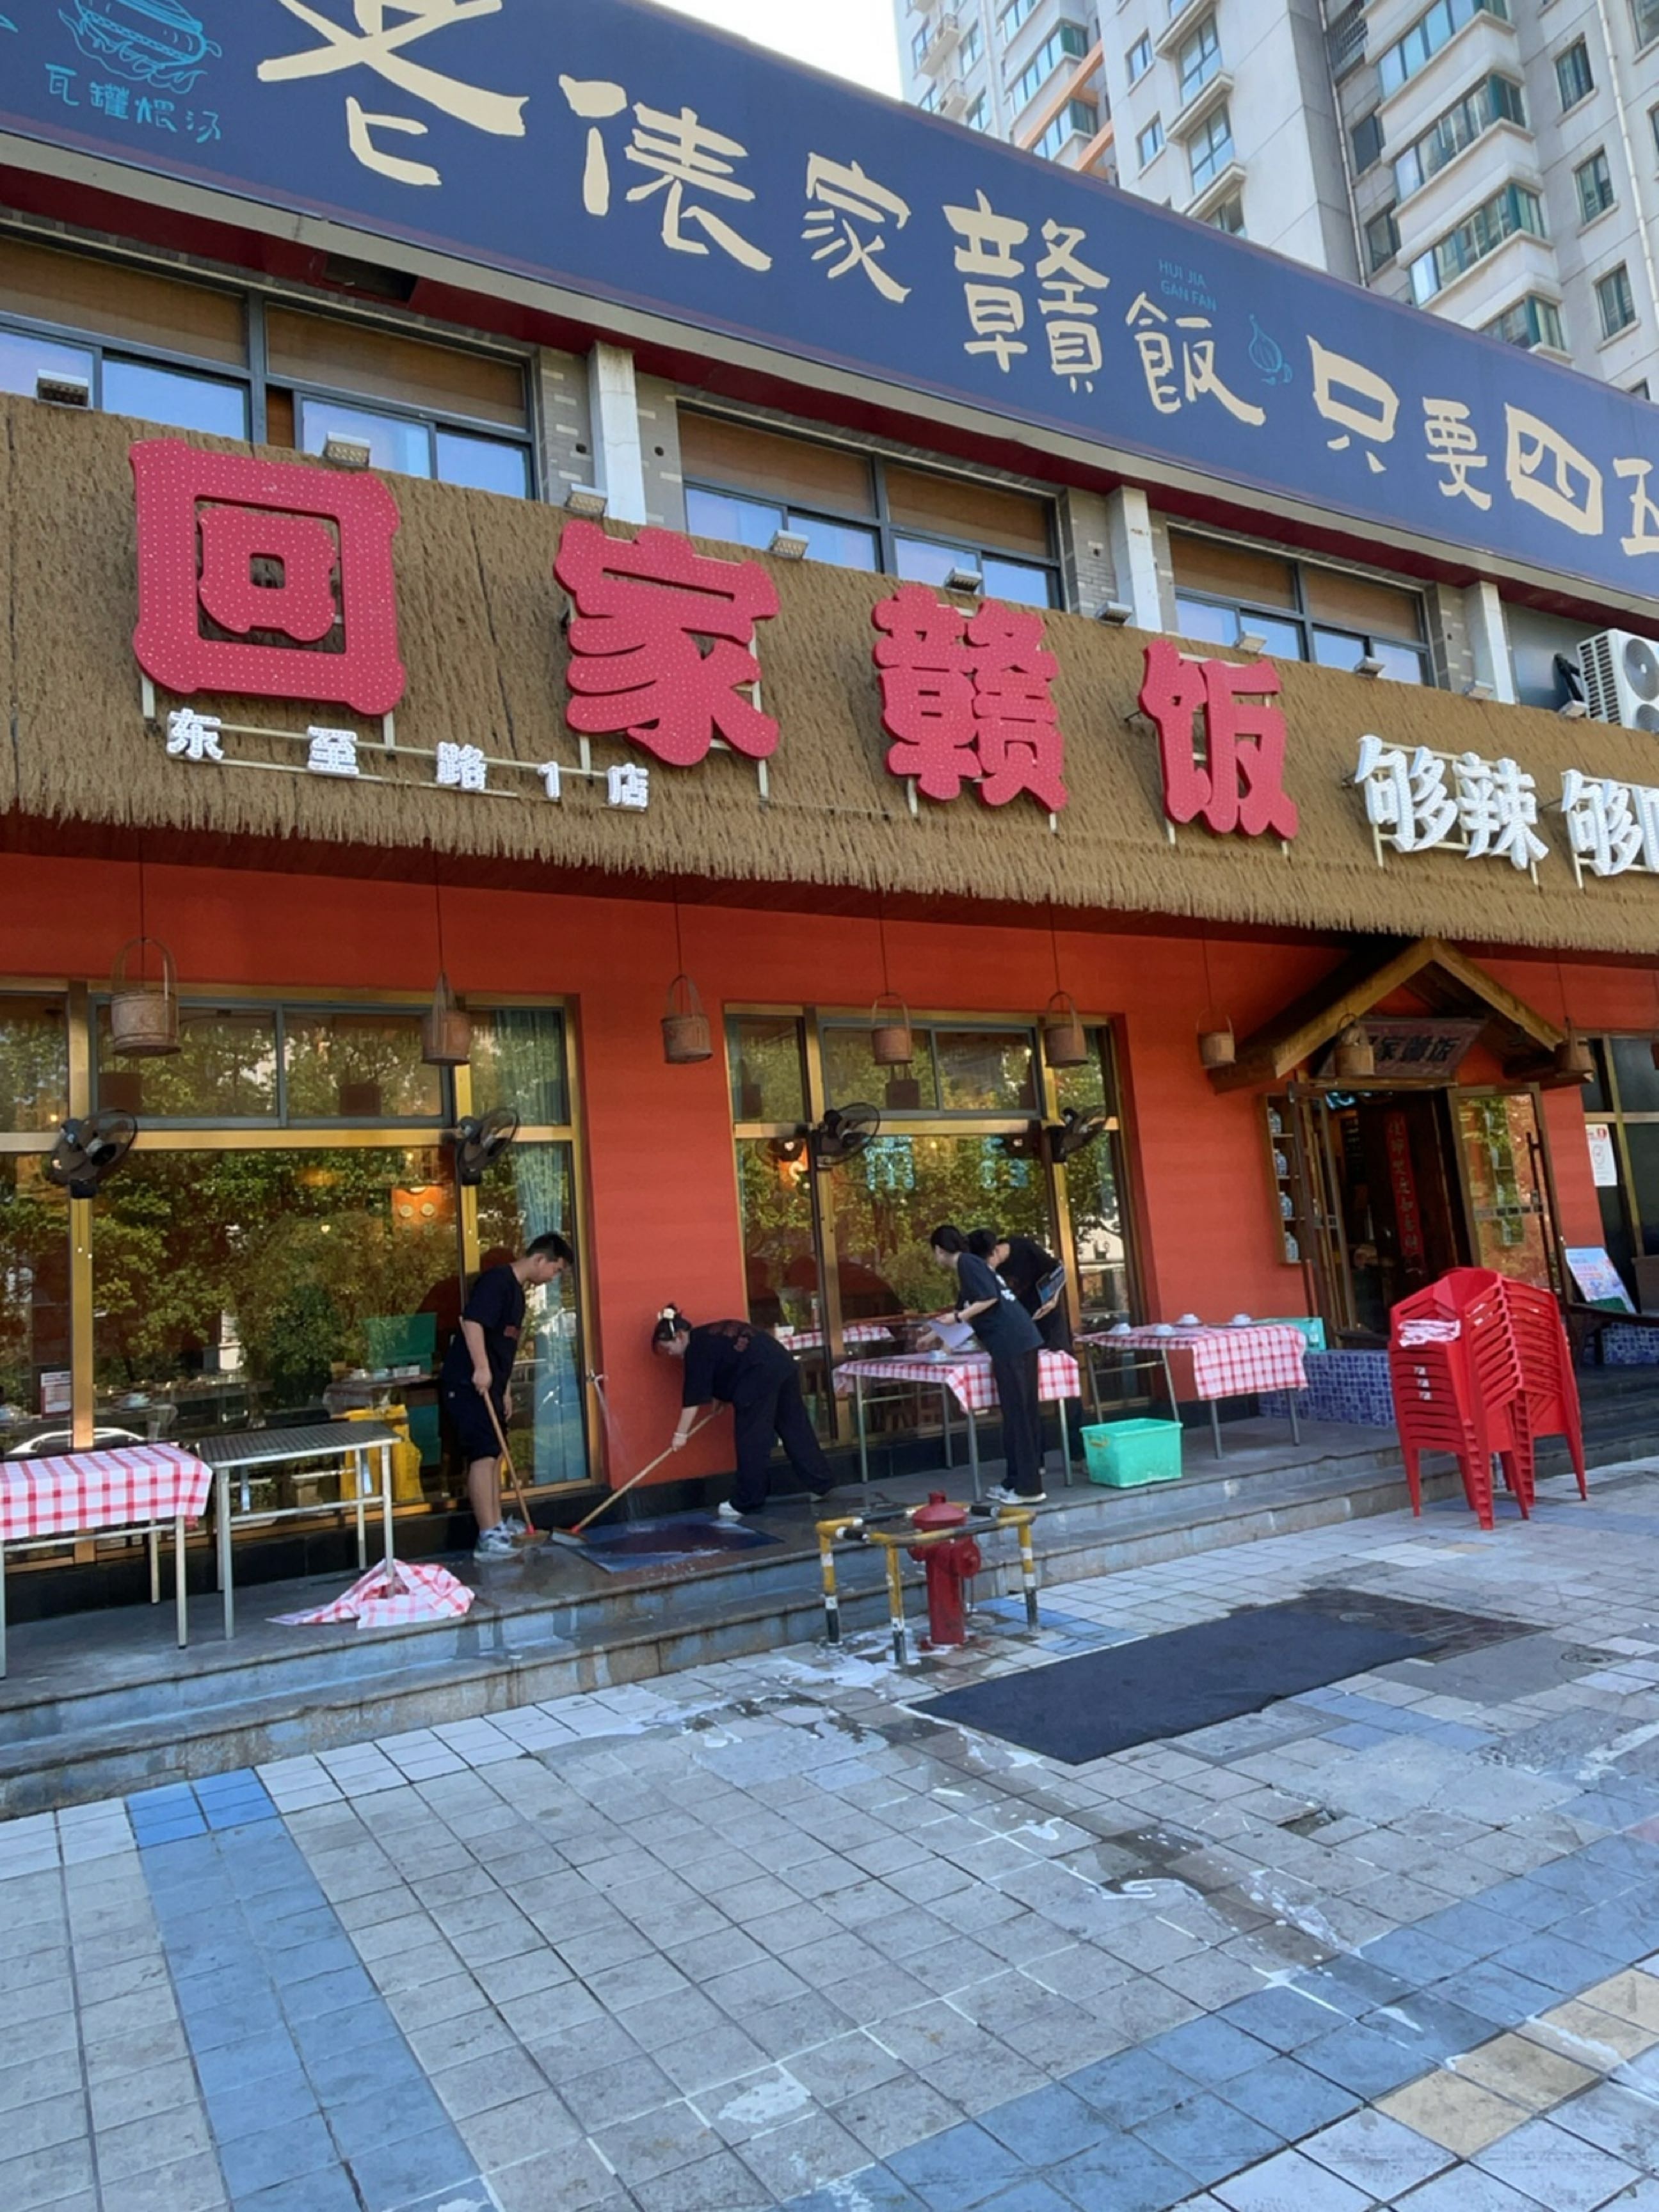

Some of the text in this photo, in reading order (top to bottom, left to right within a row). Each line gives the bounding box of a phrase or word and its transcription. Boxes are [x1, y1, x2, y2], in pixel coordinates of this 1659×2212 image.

[45, 63, 221, 143] 瓦罐煨汤
[1158, 259, 1207, 289] HUI JIA
[1161, 280, 1217, 312] GAN FAN
[129, 437, 1299, 840] 回家赣饭
[166, 708, 650, 808] 东至路1店
[1354, 735, 1550, 870] 够辣
